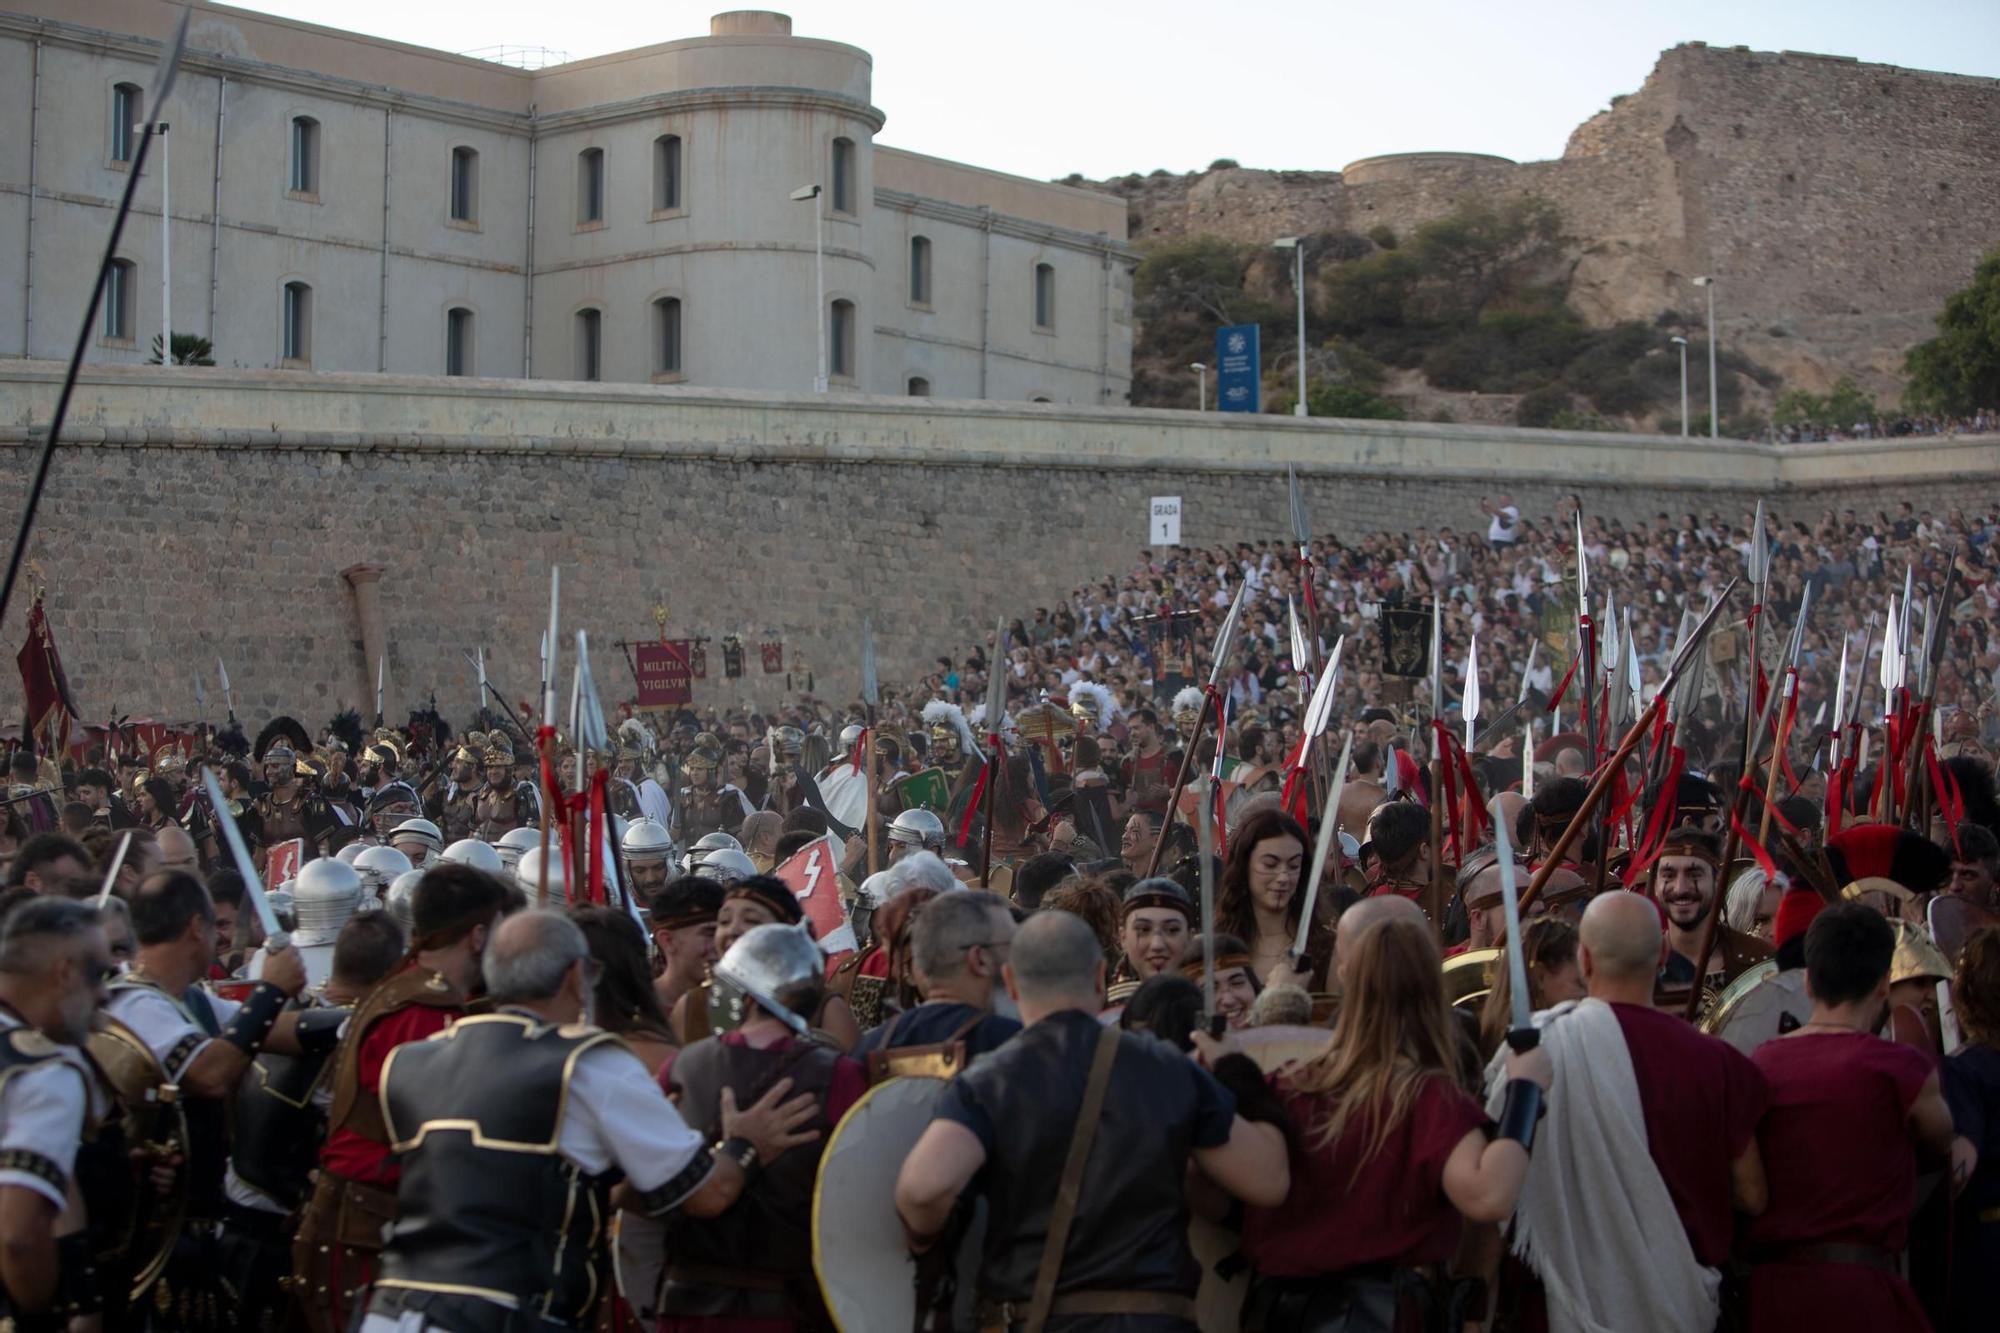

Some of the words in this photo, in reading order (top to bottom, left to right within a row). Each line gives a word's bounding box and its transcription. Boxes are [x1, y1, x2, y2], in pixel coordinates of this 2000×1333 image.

[1153, 504, 1178, 516] GRADA
[1161, 523, 1169, 538] 1
[642, 678, 687, 690] VIGILVM
